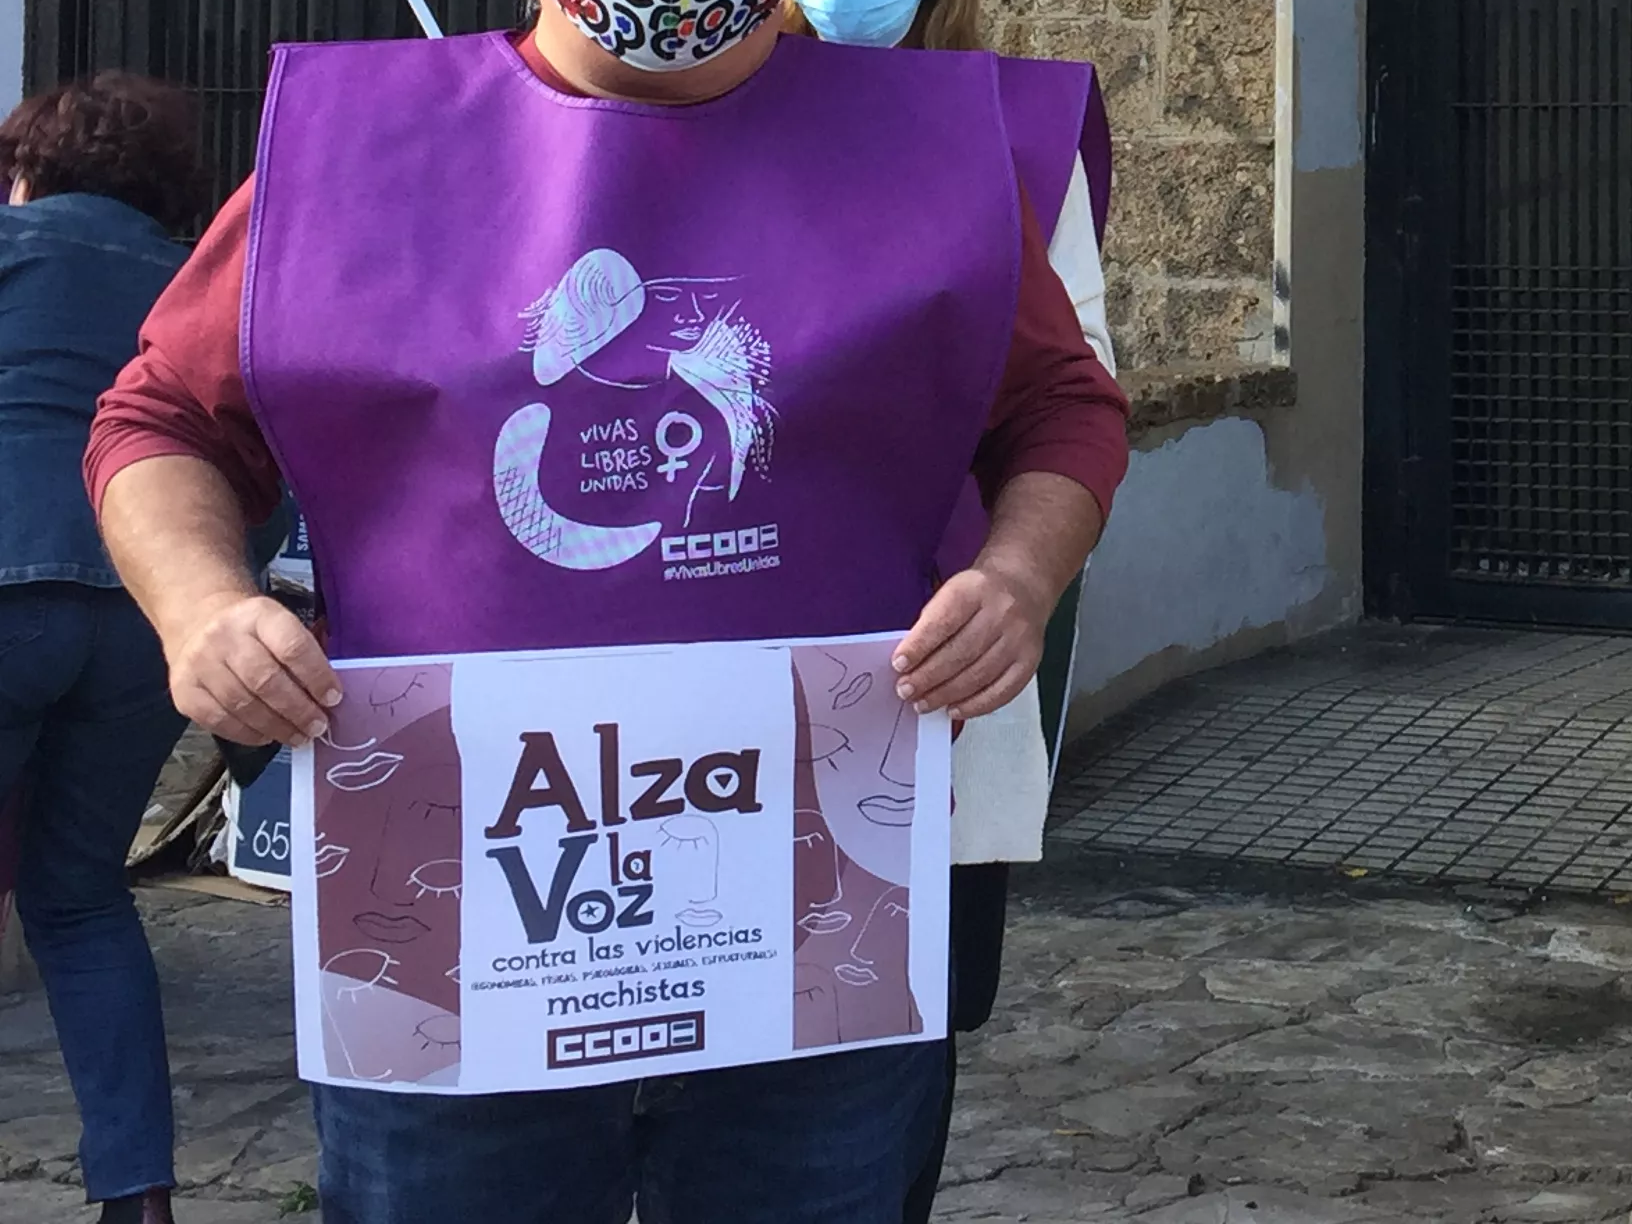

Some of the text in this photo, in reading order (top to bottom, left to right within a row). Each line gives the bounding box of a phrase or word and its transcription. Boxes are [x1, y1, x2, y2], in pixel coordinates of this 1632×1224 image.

[580, 418, 638, 444] VIVAS
[581, 445, 652, 472] LIBRES
[580, 471, 648, 493] UNIDAS
[484, 722, 764, 840] Alza
[252, 819, 290, 861] 65
[606, 832, 653, 886] la
[485, 833, 655, 945] Voz
[492, 925, 764, 973] contra las violencias
[547, 978, 706, 1017] machistas
[555, 1022, 669, 1062] CCOO
